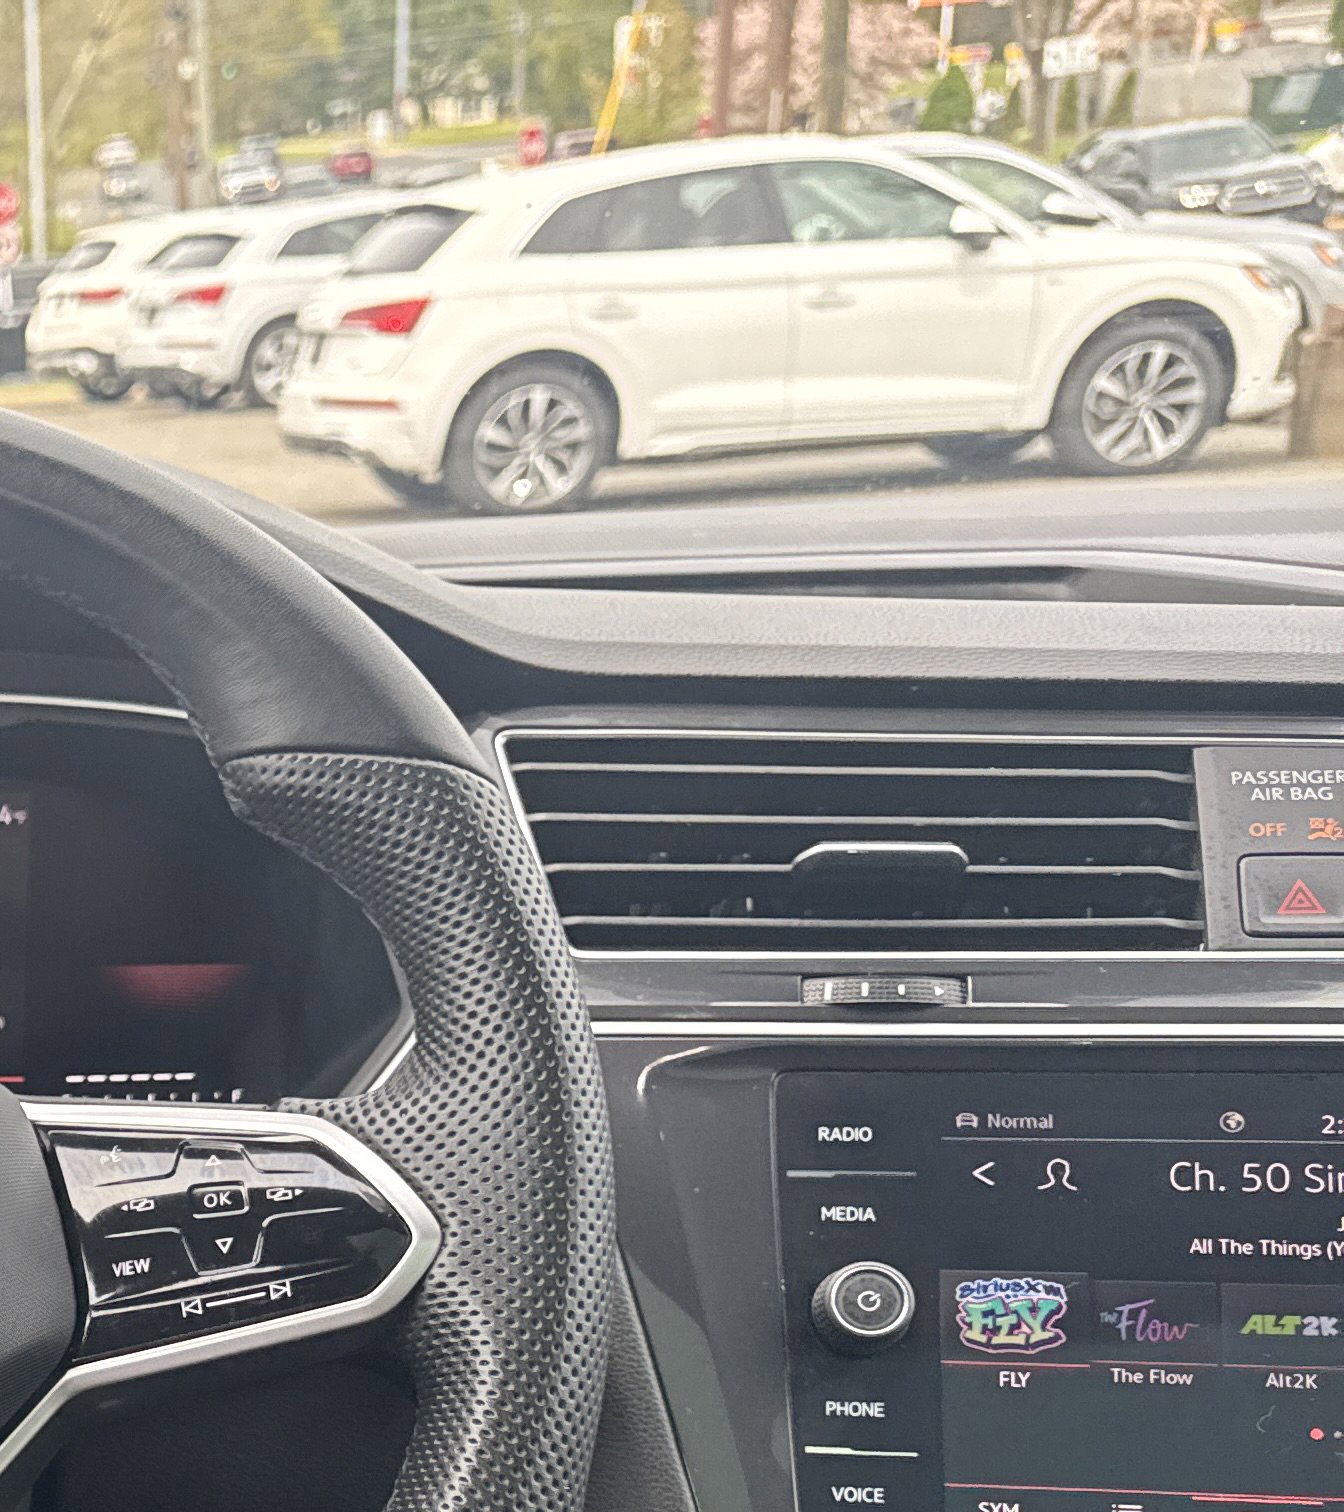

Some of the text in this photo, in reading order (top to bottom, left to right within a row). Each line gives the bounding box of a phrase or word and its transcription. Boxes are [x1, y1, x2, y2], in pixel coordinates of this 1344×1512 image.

[1230, 769, 1344, 786] PASSENGER
[1250, 786, 1334, 801] AIR BAG
[1248, 822, 1288, 837] OFF
[986, 1112, 1054, 1130] Normal
[817, 1126, 873, 1143] RADIO
[1169, 1161, 1226, 1192] Ch.
[1241, 1162, 1291, 1193] 50
[203, 1190, 232, 1209] OK
[820, 1205, 876, 1223] MEDIA
[1189, 1238, 1212, 1255] All
[1218, 1238, 1254, 1255] The
[1258, 1239, 1322, 1260] Things
[111, 1257, 151, 1277] VIEW
[963, 1297, 1062, 1346] FLY
[1114, 1298, 1200, 1342] Flow
[1238, 1313, 1340, 1337] ALT2K
[998, 1370, 1031, 1388] FLY
[1110, 1367, 1194, 1386] The Flow
[1265, 1373, 1318, 1391] Alt2K
[825, 1400, 886, 1418] PHONE
[831, 1486, 885, 1504] VOICE
